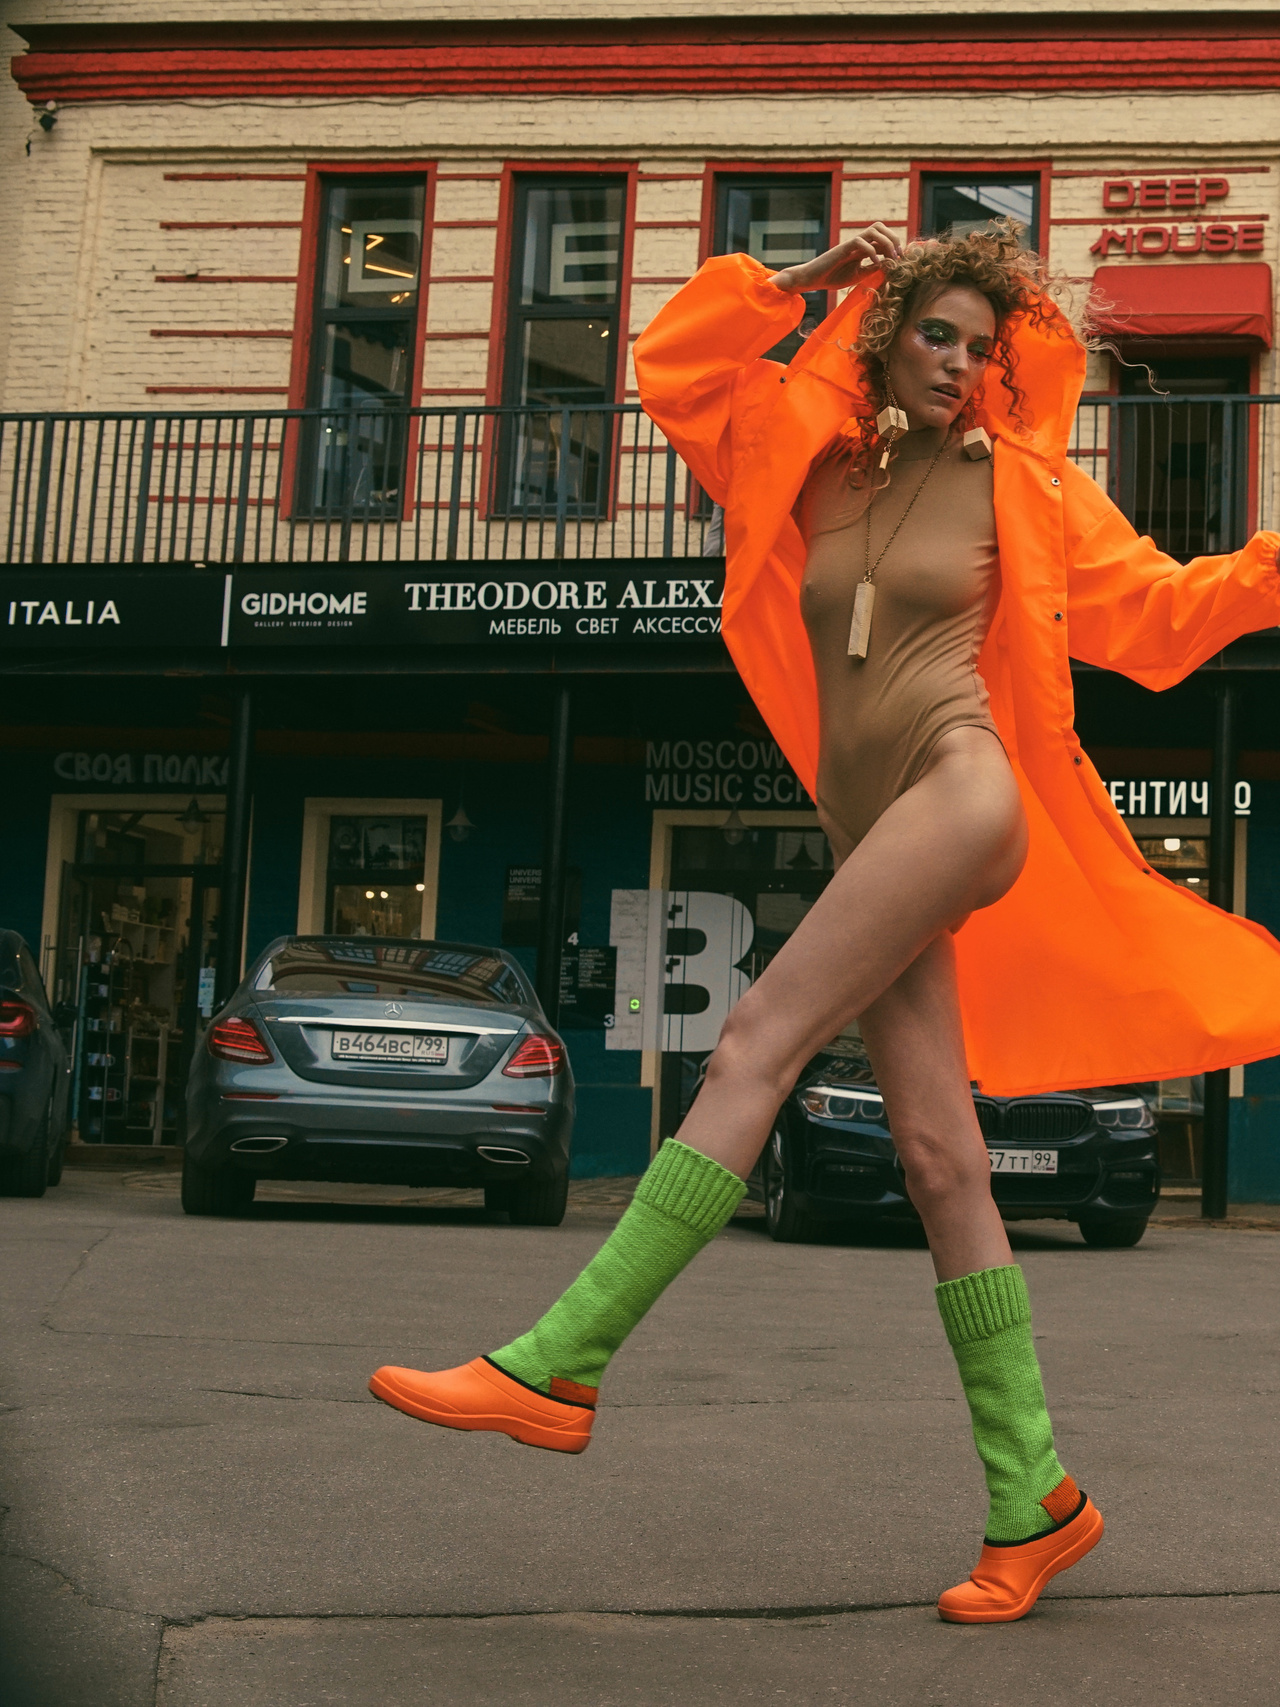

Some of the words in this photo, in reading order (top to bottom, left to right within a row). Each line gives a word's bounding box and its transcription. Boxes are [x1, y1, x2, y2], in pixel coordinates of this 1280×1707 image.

[1103, 178, 1230, 208] DEEP
[241, 592, 367, 615] GIDHOME
[404, 581, 607, 611] THEODORE
[9, 601, 120, 625] ITALIA
[489, 618, 562, 635] МЕБЕЛЬ
[576, 618, 619, 635] СВЕТ
[646, 740, 786, 770] MOSCOW
[54, 752, 134, 784] СВОЯ
[645, 773, 743, 803] MUSIC
[567, 932, 579, 946] 4
[603, 1014, 615, 1028] 3
[415, 1037, 443, 1051] 799
[1034, 1152, 1051, 1165] 99
